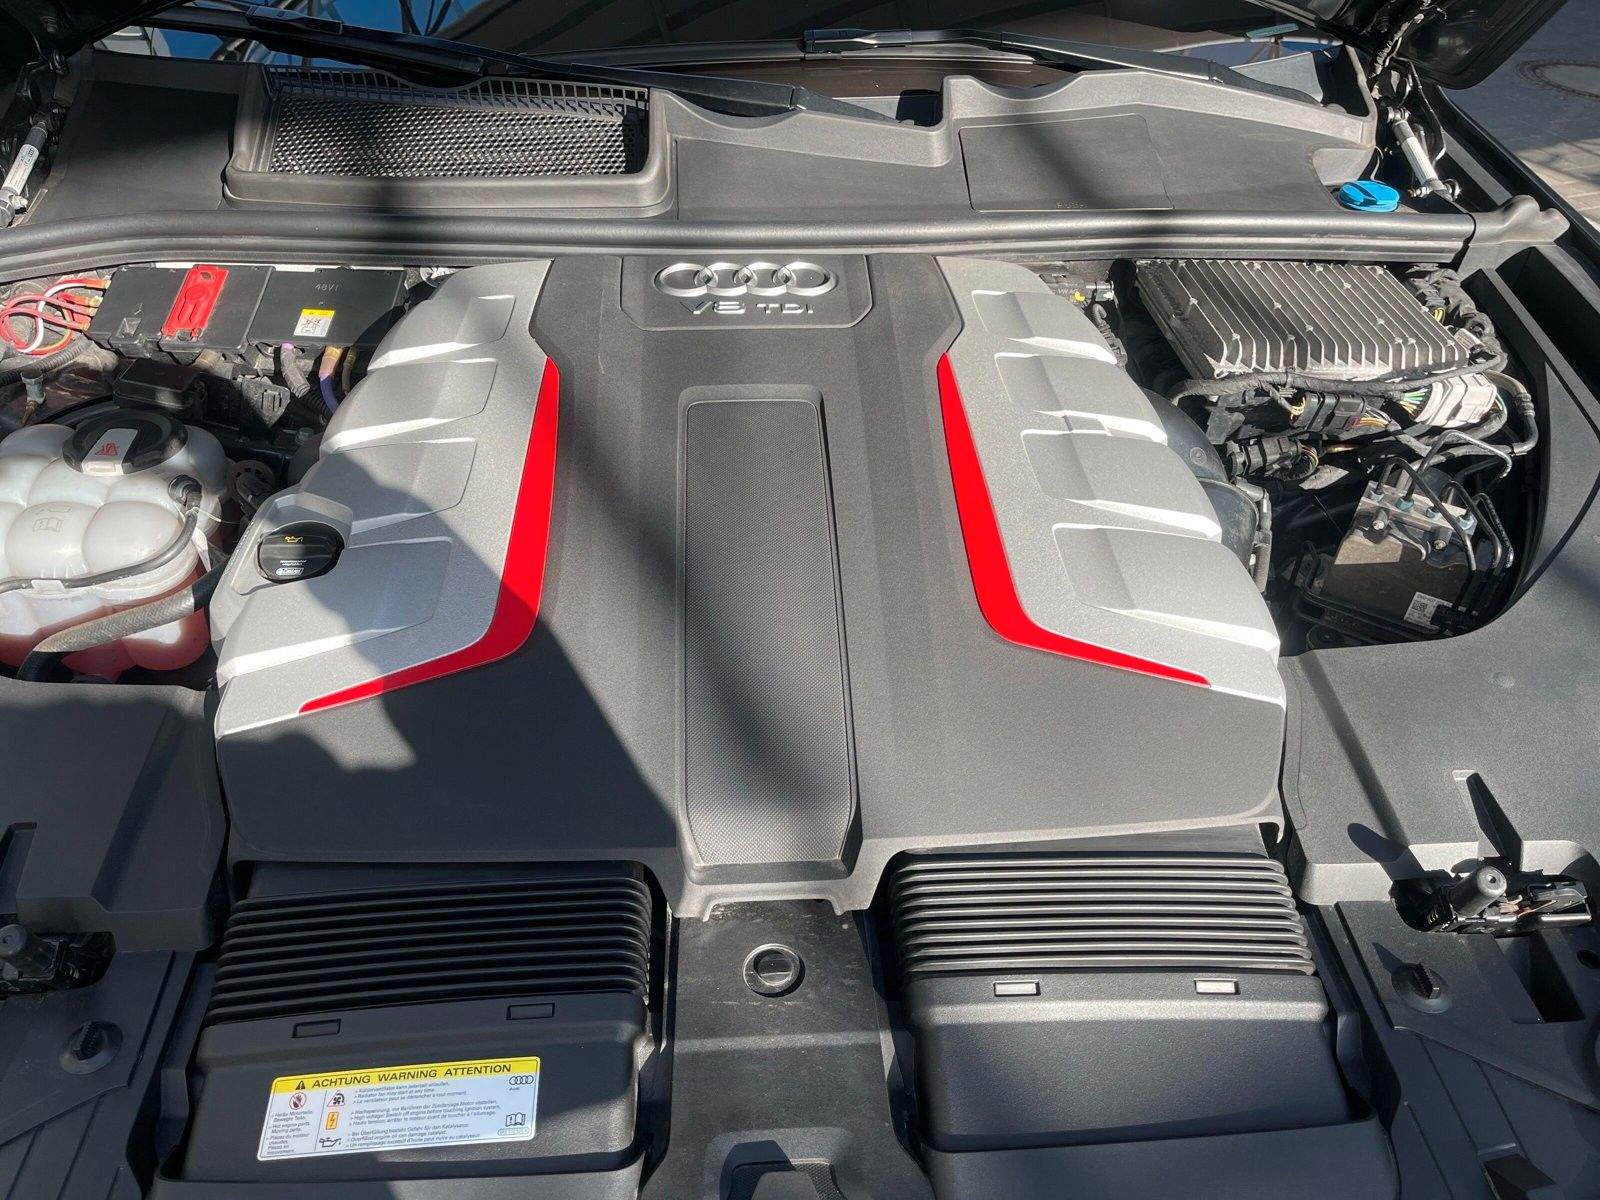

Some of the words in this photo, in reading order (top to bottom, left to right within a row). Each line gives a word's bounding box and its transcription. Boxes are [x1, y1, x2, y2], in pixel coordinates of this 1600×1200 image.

[756, 303, 814, 314] TDI
[311, 1075, 370, 1087] ACHTUNG
[377, 1069, 437, 1081] WARNING
[444, 1063, 511, 1076] ATTENTION
